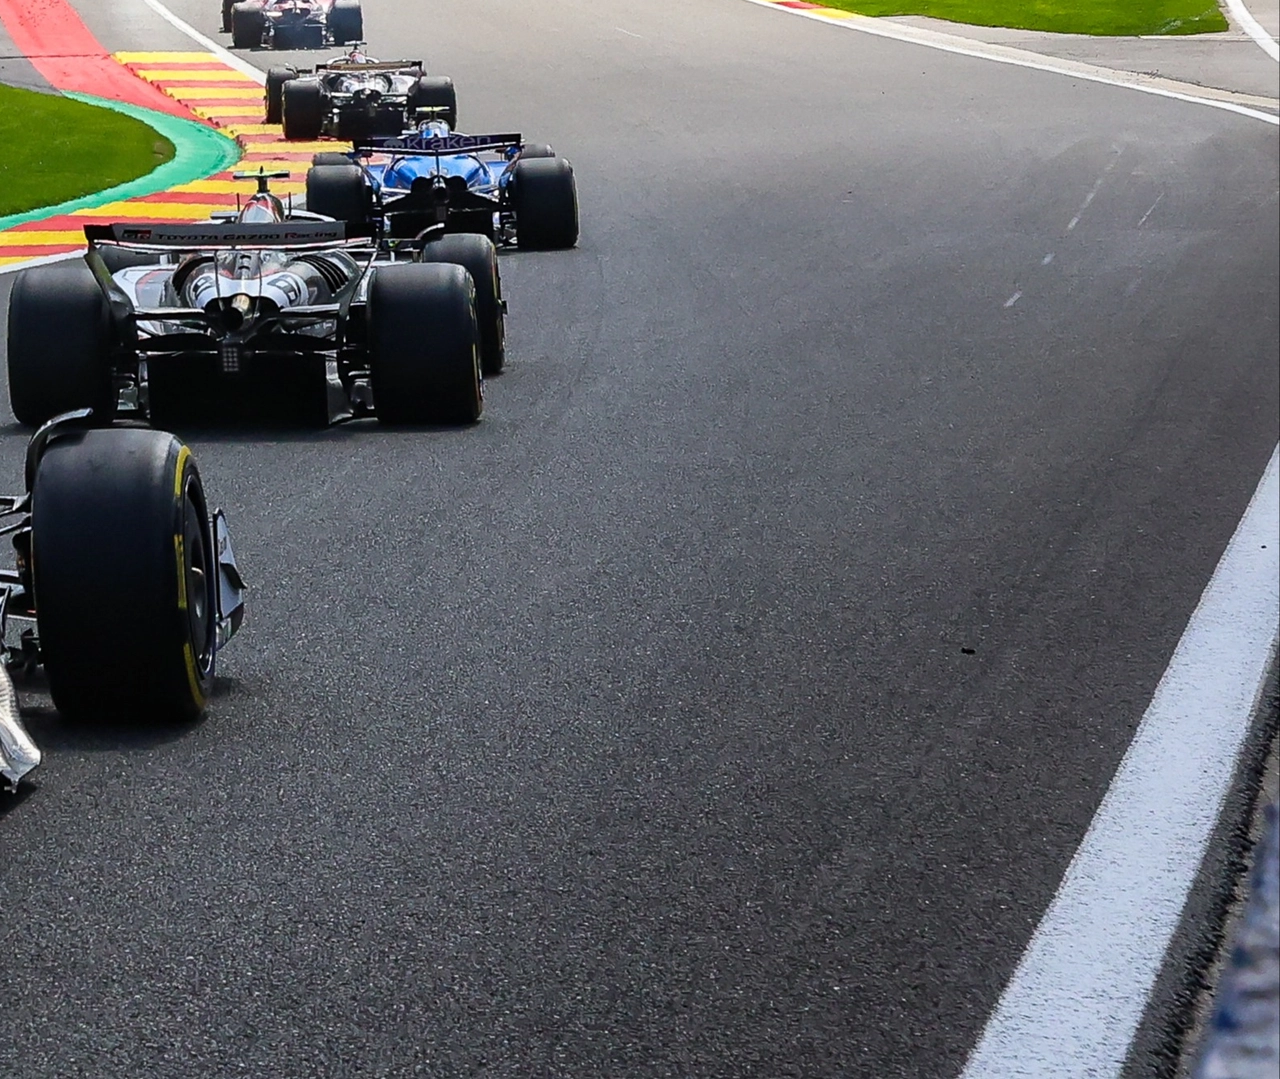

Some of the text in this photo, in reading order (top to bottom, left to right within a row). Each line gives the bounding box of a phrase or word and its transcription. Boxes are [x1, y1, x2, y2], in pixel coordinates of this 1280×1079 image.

[406, 136, 491, 149] kraken
[155, 233, 218, 241] TOYOTA
[222, 233, 280, 241] GAZOO
[284, 231, 338, 240] Racing
